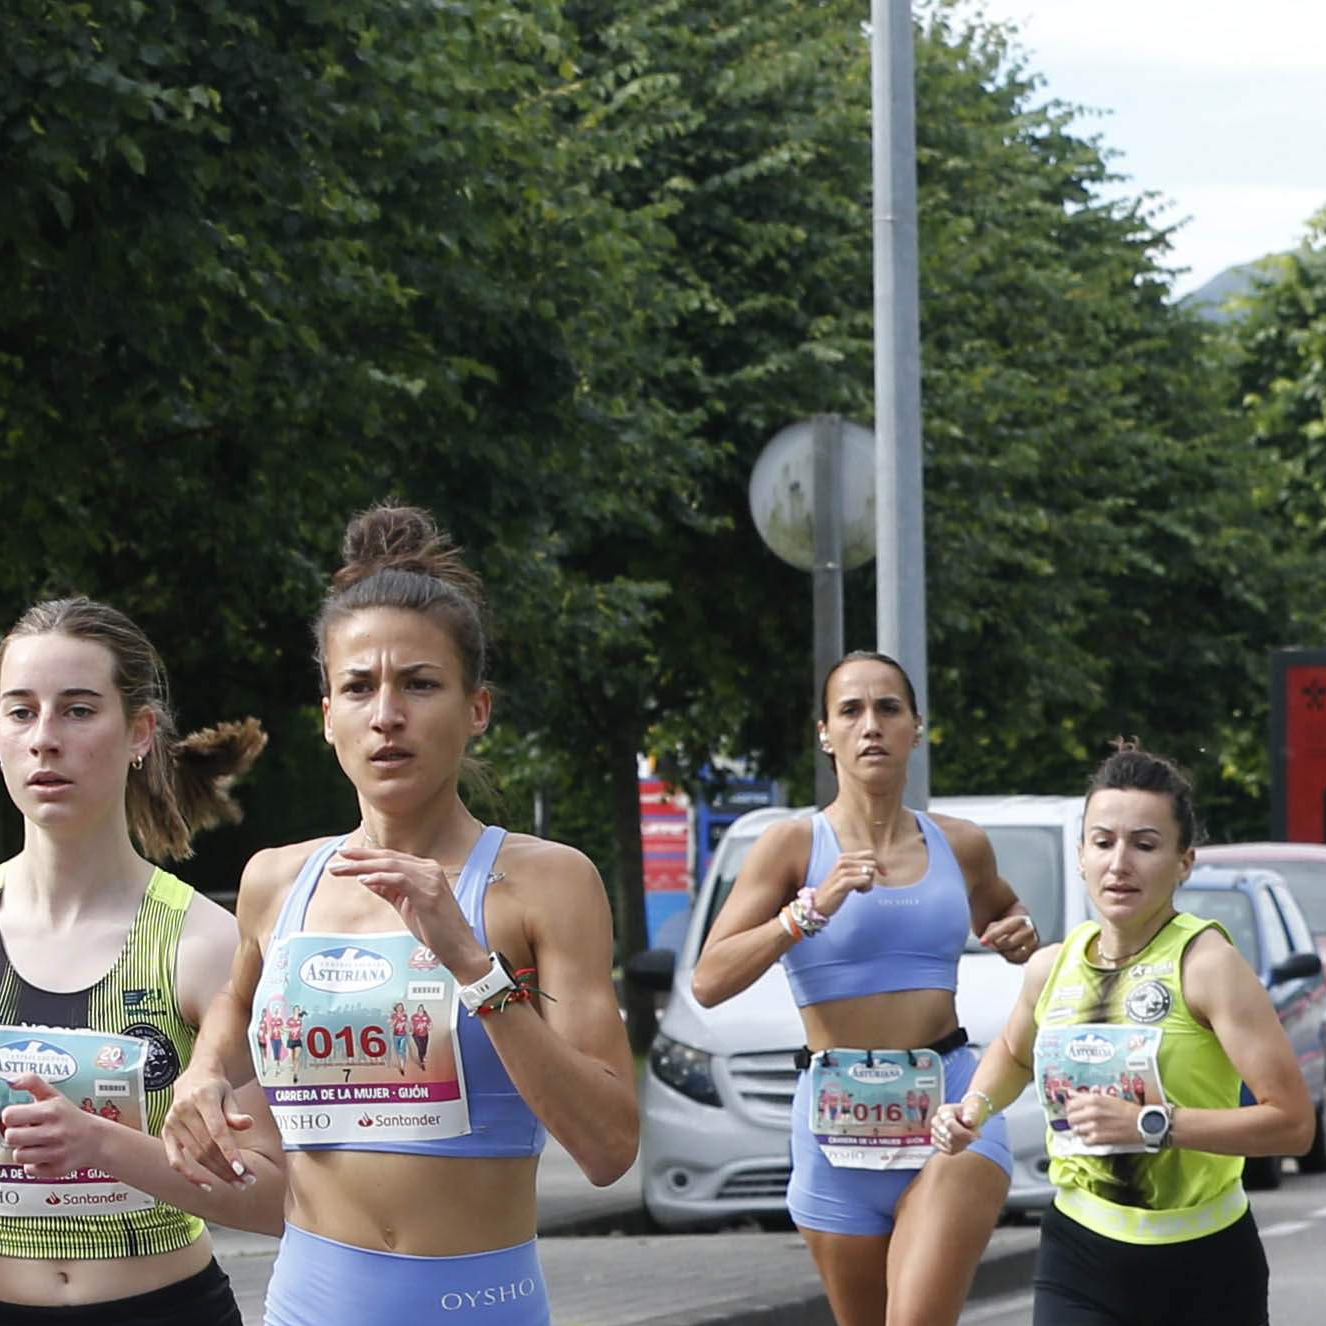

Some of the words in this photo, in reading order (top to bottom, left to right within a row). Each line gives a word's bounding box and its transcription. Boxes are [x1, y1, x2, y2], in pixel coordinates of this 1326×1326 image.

[306, 963, 387, 981] ASTURIANA
[306, 1025, 387, 1059] 016
[342, 1068, 352, 1083] 7
[275, 1089, 318, 1102] CARRERA
[320, 1089, 335, 1101] DE
[337, 1088, 351, 1100] LA
[353, 1087, 390, 1100] MUJER
[397, 1084, 429, 1099] GIJÓN
[375, 1114, 442, 1127] Santander
[853, 1103, 903, 1122] 016
[62, 1191, 129, 1206] Santander
[440, 1277, 535, 1311] OYSHO
